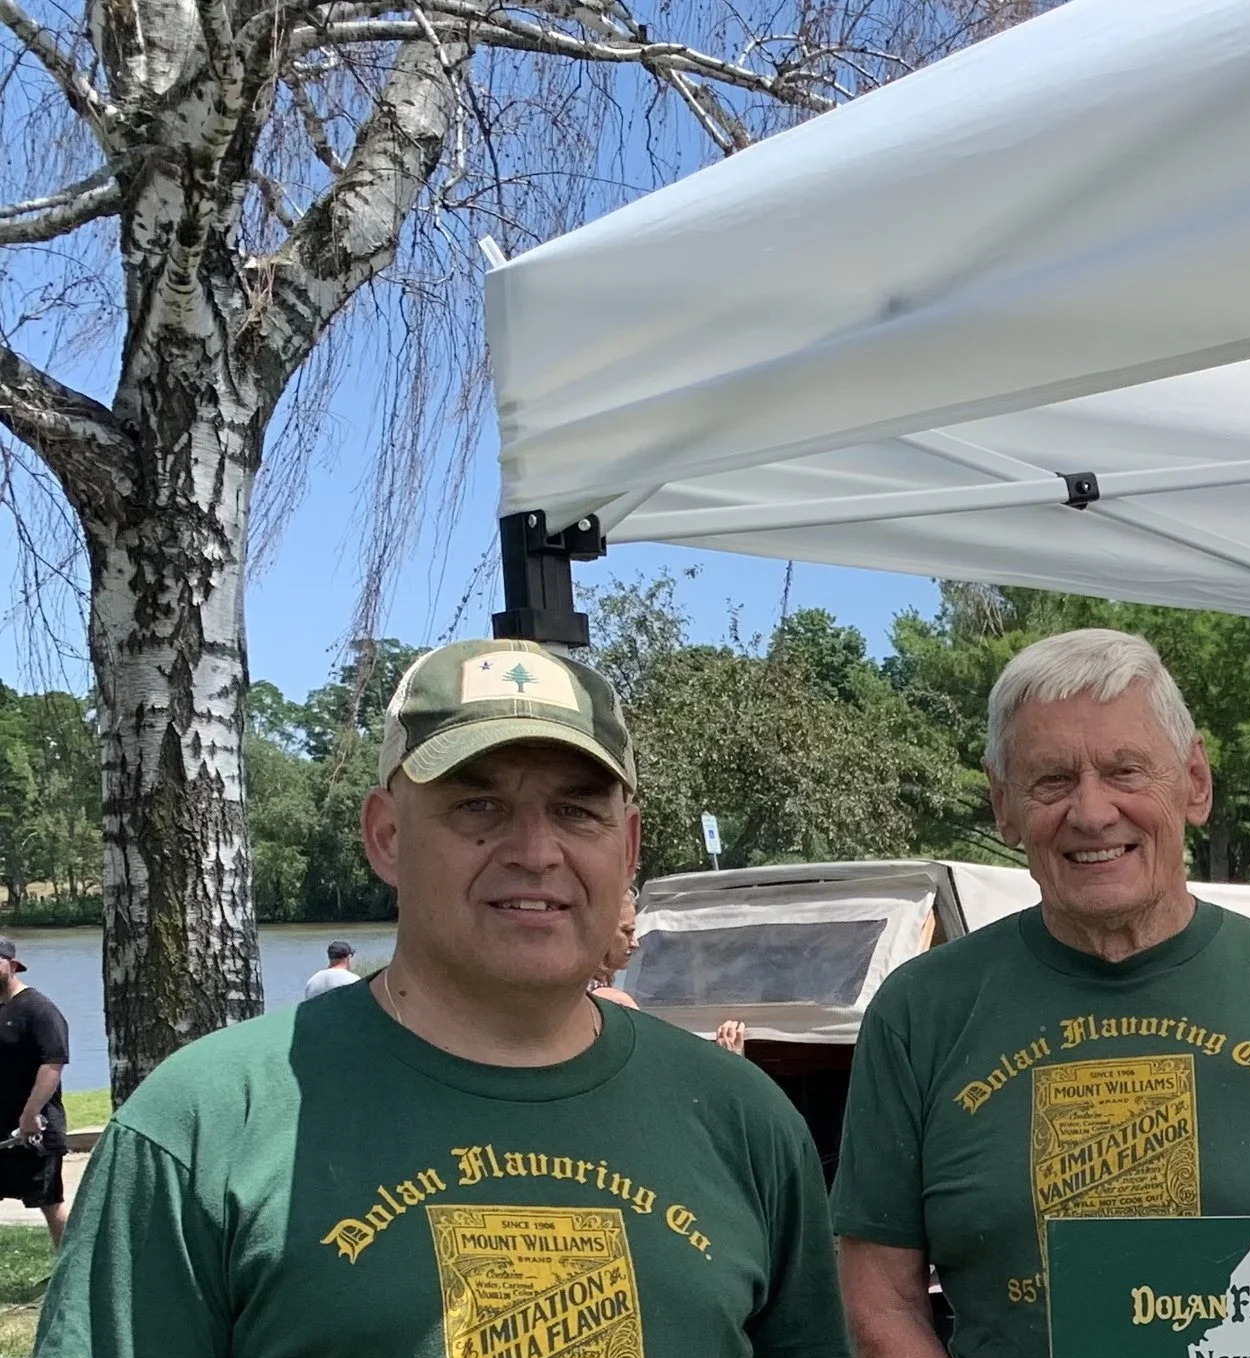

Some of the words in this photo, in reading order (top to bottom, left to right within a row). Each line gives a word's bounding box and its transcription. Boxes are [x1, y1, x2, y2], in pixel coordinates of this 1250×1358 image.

[953, 1038, 1051, 1115] Dolan
[1059, 1013, 1228, 1055] Flavoring
[1054, 1083, 1102, 1100] MOUNT
[1105, 1077, 1175, 1095] WILLIAMS
[1090, 1070, 1113, 1079] SINCE
[1039, 1158, 1113, 1205] VANILLA
[1118, 1118, 1190, 1171] FLAVOR
[1060, 1104, 1169, 1174] IMITATION
[320, 1165, 446, 1264] Dolan
[451, 1144, 658, 1215] Flavoring
[665, 1204, 712, 1261] Co.
[501, 1220, 529, 1229] SINCE
[534, 1221, 555, 1230] 1906
[1073, 1199, 1095, 1208] WILL
[461, 1233, 517, 1251] MOUNT
[521, 1234, 605, 1252] WILLIAMS
[480, 1271, 605, 1355] IMITATION
[547, 1290, 632, 1351] FLAVOR
[1131, 1285, 1228, 1331] DOLAN
